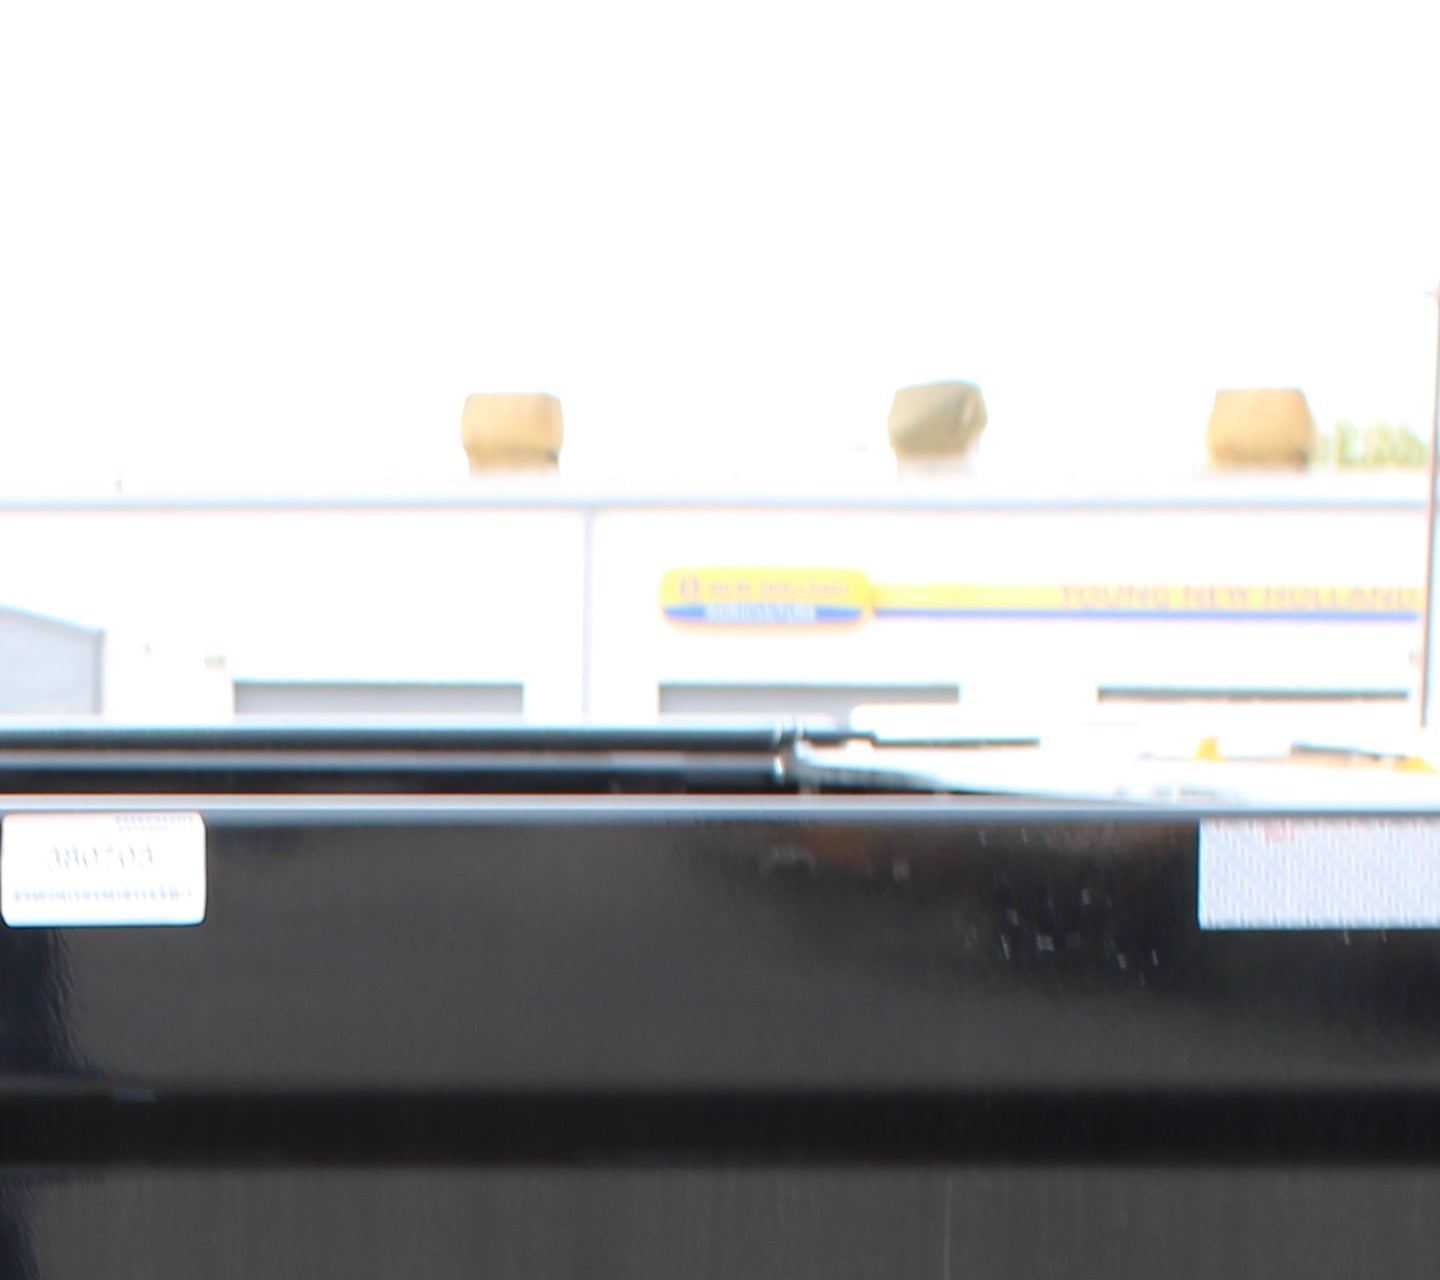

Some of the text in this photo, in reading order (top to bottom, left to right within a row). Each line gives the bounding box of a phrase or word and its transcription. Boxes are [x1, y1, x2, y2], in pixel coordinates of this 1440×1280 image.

[1058, 585, 1417, 611] YOUNG NEW HOLLAND
